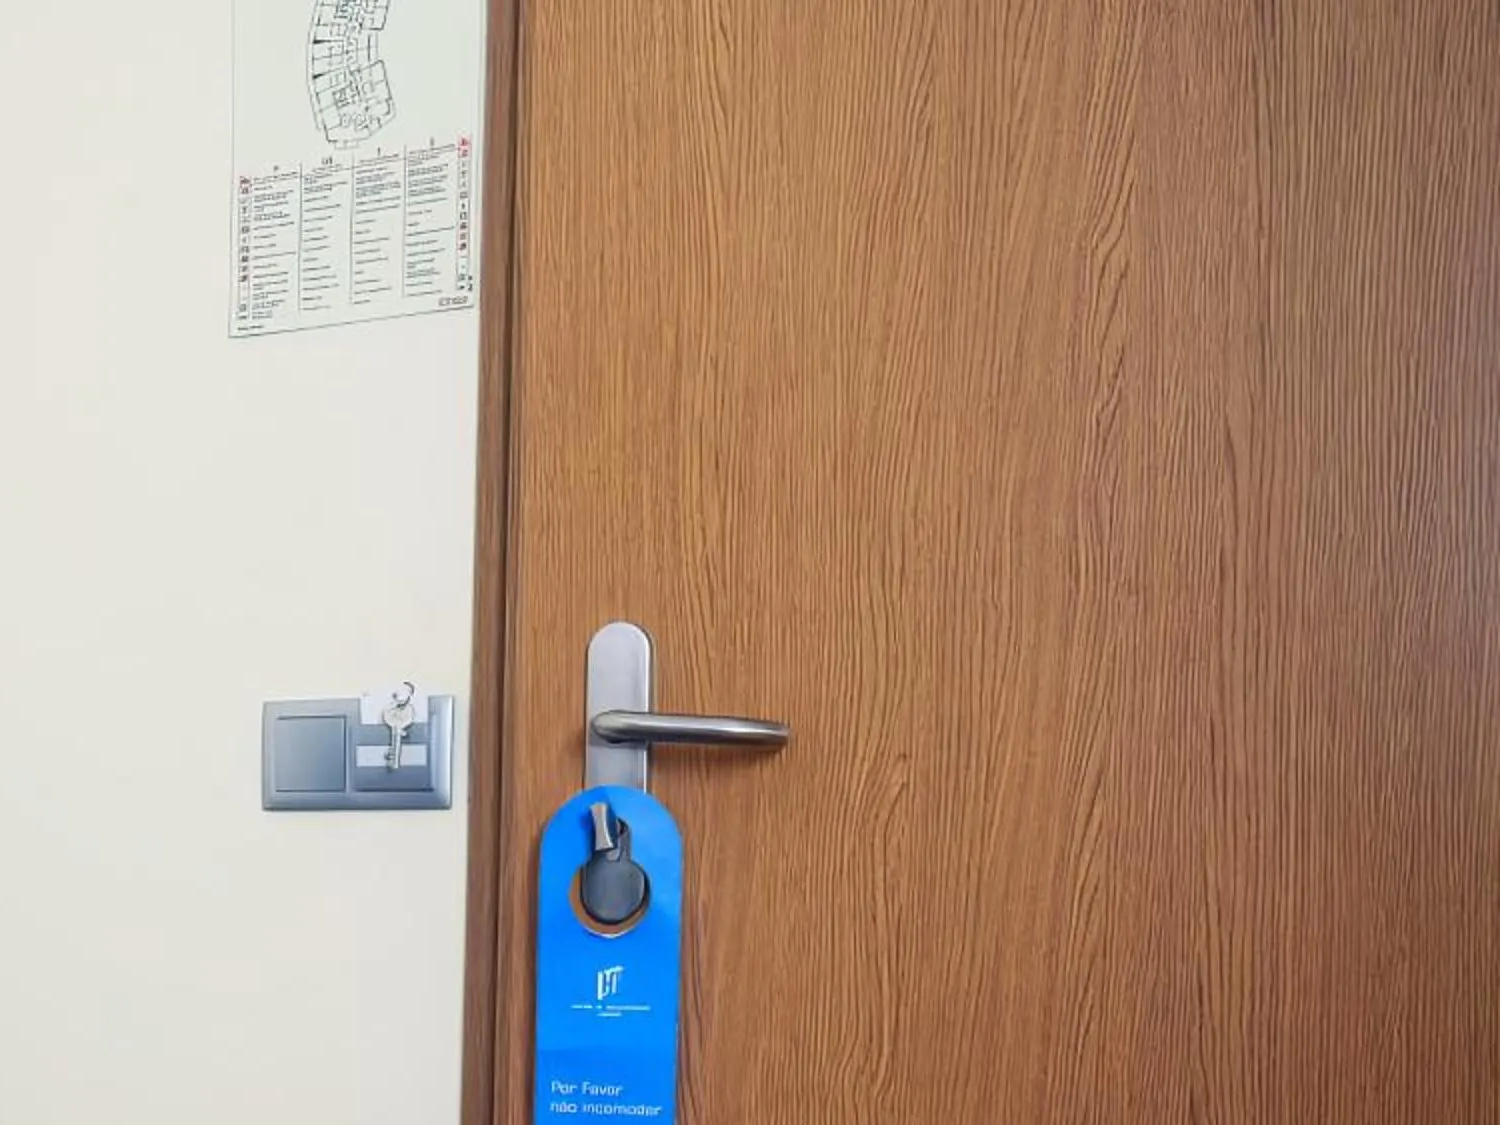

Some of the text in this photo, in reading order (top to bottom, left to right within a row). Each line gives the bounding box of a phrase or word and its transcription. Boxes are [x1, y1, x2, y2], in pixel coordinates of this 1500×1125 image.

[550, 1081, 623, 1097] Por Favor
[549, 1100, 578, 1114] não
